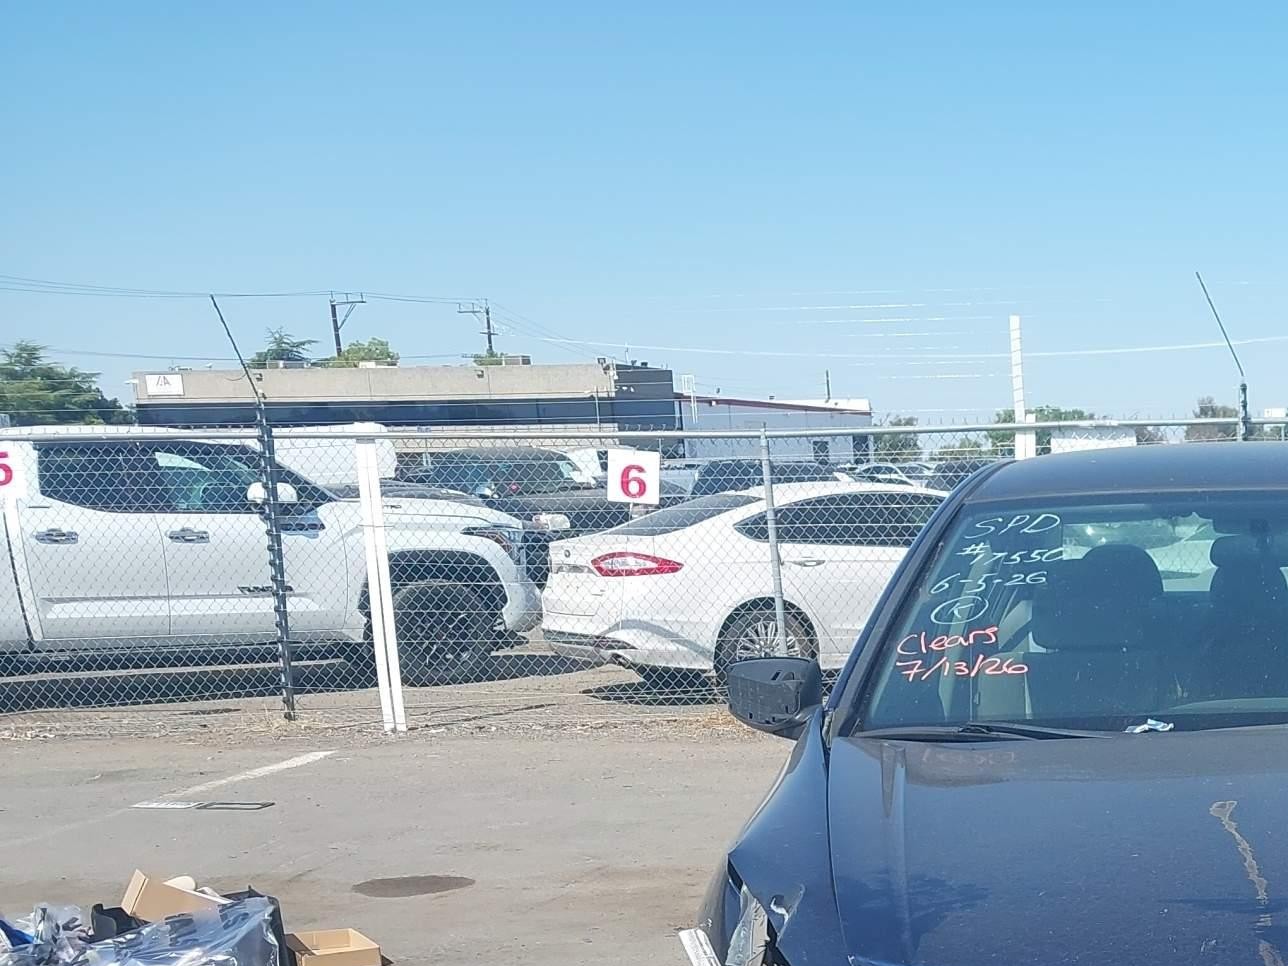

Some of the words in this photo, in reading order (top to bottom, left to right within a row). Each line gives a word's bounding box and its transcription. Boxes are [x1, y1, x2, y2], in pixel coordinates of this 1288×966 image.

[621, 464, 647, 499] 6
[964, 513, 1061, 539] SPD
[930, 571, 1048, 594] 6-5-26
[895, 654, 1029, 682] 7/13/26
